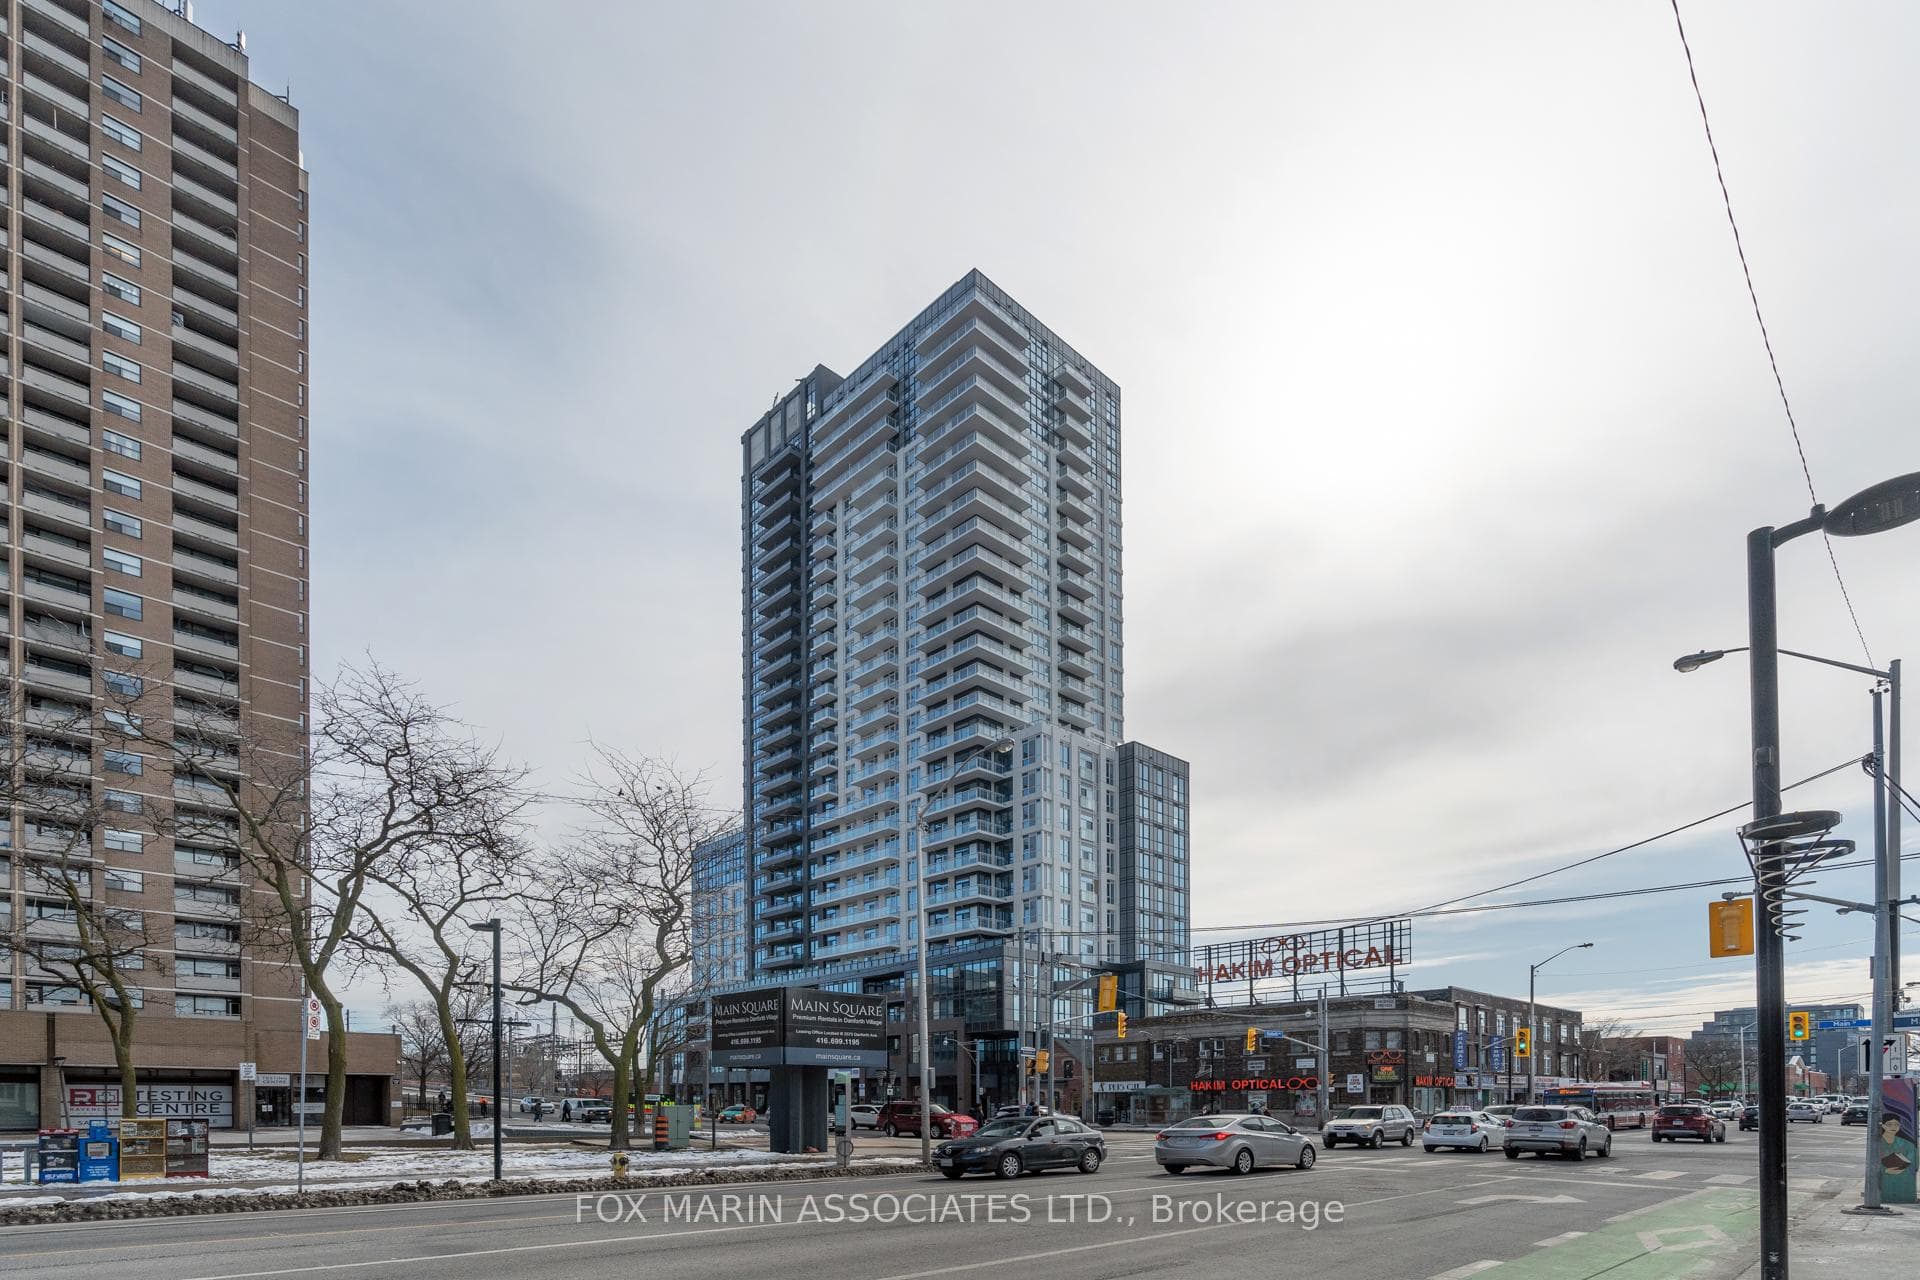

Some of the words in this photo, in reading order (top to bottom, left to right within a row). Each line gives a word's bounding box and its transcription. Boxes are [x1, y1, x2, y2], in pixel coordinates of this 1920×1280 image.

[1198, 958, 1273, 983] HAKIM
[1282, 944, 1403, 974] OPTICAL
[714, 1003, 740, 1017] MAIN
[741, 999, 779, 1016] SQUARE
[791, 997, 829, 1013] MAIN
[832, 1001, 883, 1018] SQUARE
[866, 1018, 882, 1026] Village
[816, 1053, 861, 1061] mainsquare.ca
[1190, 1079, 1226, 1091] HAKIM
[1231, 1079, 1286, 1090] OPTICAL
[1415, 1075, 1433, 1087] HAKIM
[136, 1090, 223, 1101] TESTING
[136, 1103, 221, 1114] CENTRE
